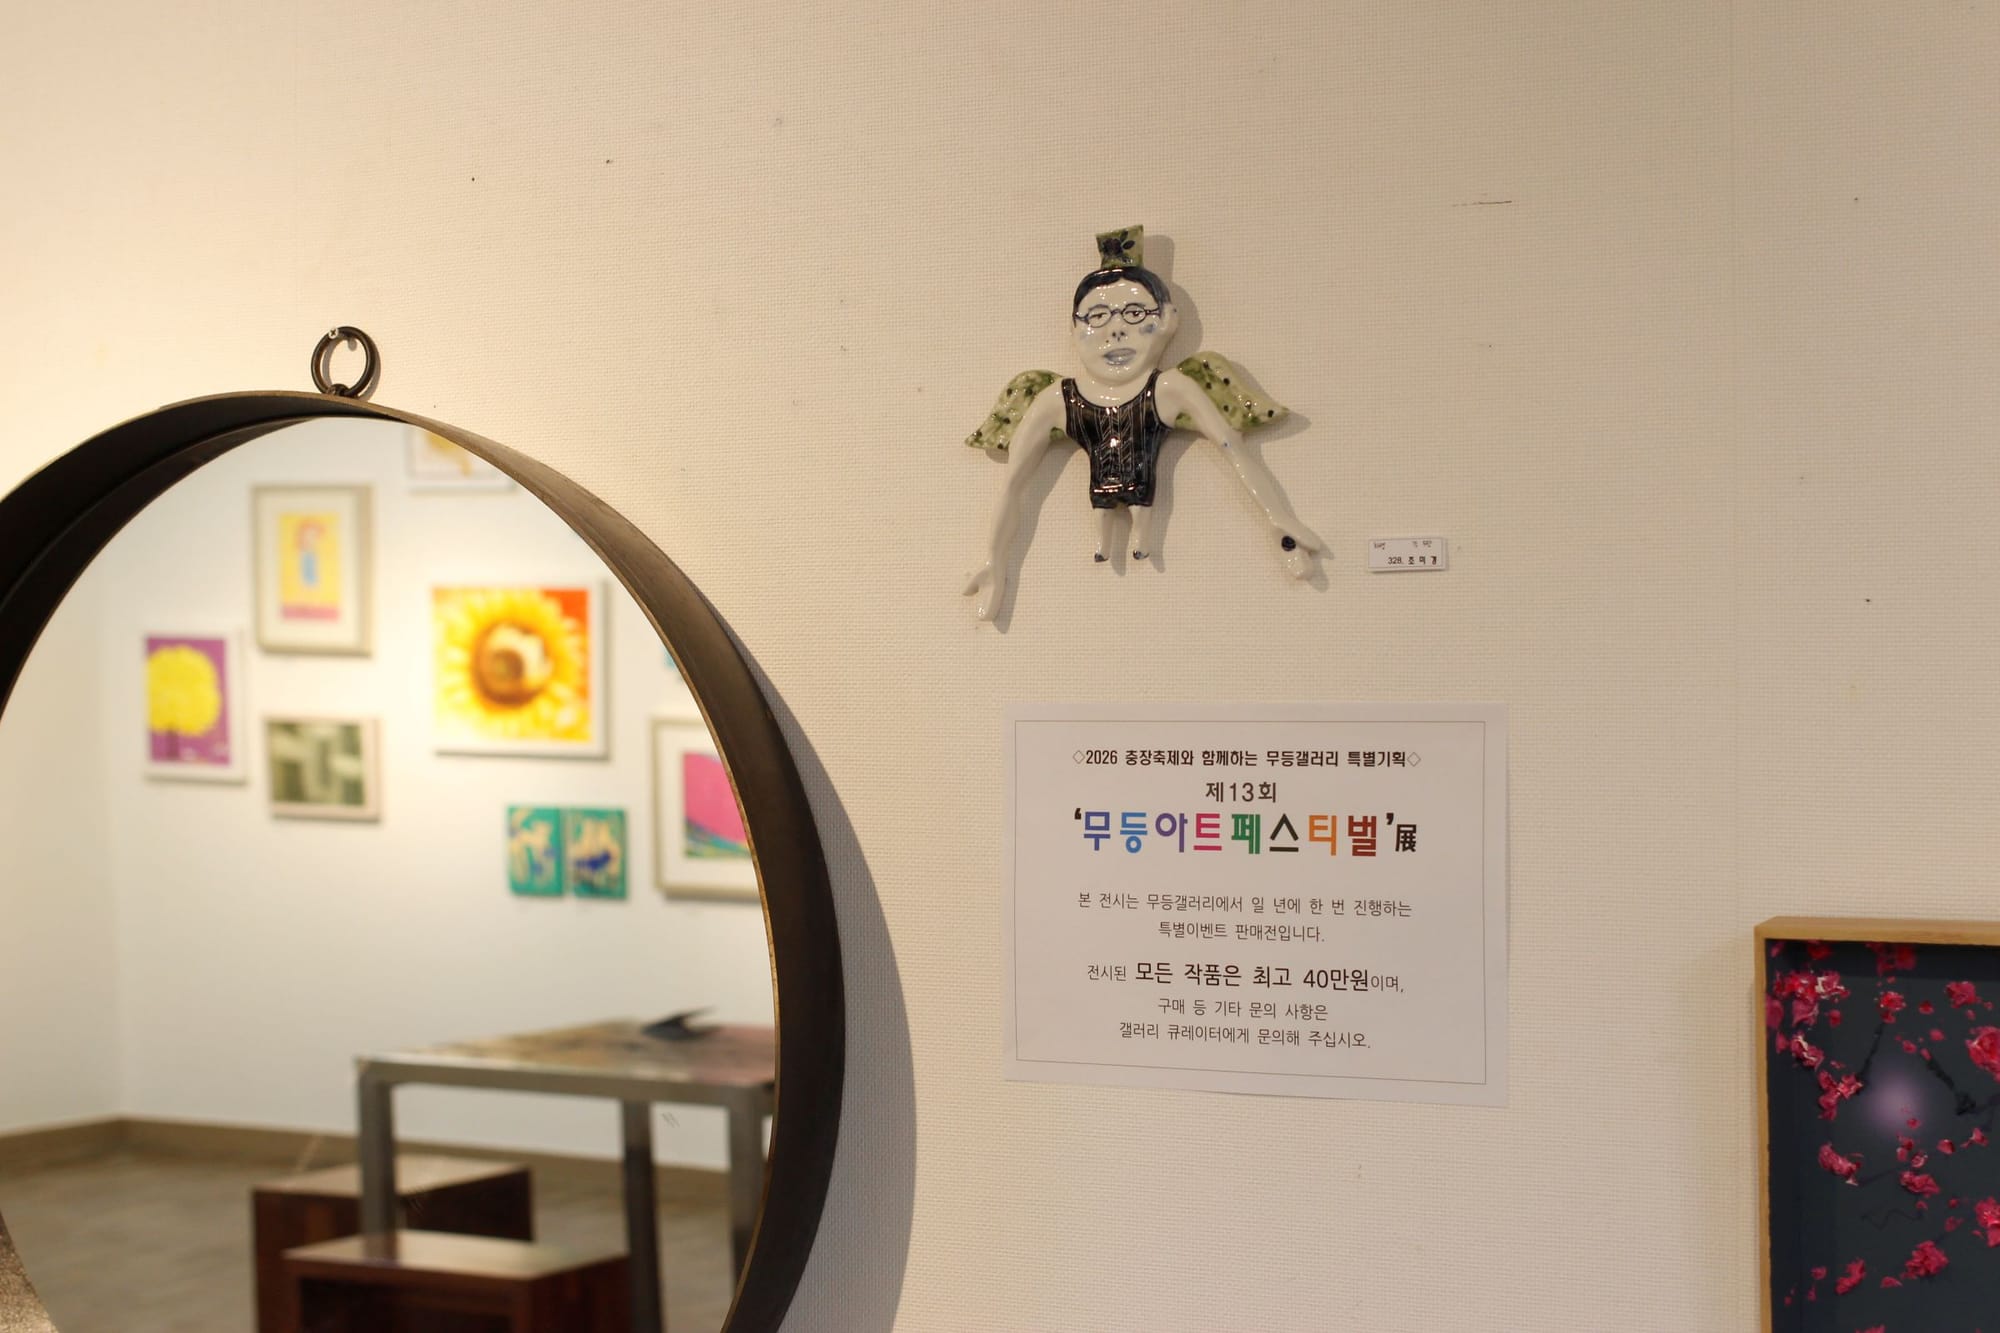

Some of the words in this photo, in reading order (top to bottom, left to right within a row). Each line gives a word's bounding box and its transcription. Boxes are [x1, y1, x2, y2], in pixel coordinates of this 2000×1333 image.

[1124, 749, 1195, 767] 충장축제와
[1201, 749, 1259, 767] 함께하는
[1265, 750, 1339, 768] 무등갤러리
[1204, 780, 1277, 804] 제13회
[1077, 891, 1092, 909] 본
[1099, 892, 1140, 910] 전시는
[1146, 893, 1243, 913] 무등갤러리에서
[1251, 896, 1265, 914] 일
[1273, 897, 1301, 915] 년에
[1308, 898, 1324, 916] 한
[1331, 898, 1345, 916] 번
[1353, 899, 1413, 918] 진행하는
[1157, 921, 1228, 940] 특별이벤트
[1234, 923, 1325, 943] 판매전입니다.
[1087, 964, 1127, 982] 전시된
[1135, 961, 1174, 985] 모든
[1183, 962, 1243, 988] 작품은
[1252, 965, 1293, 990] 최고
[1302, 968, 1404, 994] 40만원이며,
[1157, 997, 1185, 1015] 구매
[1192, 999, 1207, 1017] 등
[1214, 1000, 1243, 1018] 기타
[1248, 1001, 1277, 1020] 문의
[1284, 1003, 1329, 1022] 사항은
[1119, 1021, 1159, 1040] 갤러리
[1167, 1023, 1250, 1045] 큐레이터에게
[1256, 1028, 1300, 1047] 문의해
[1307, 1030, 1371, 1049] 주십시오.
